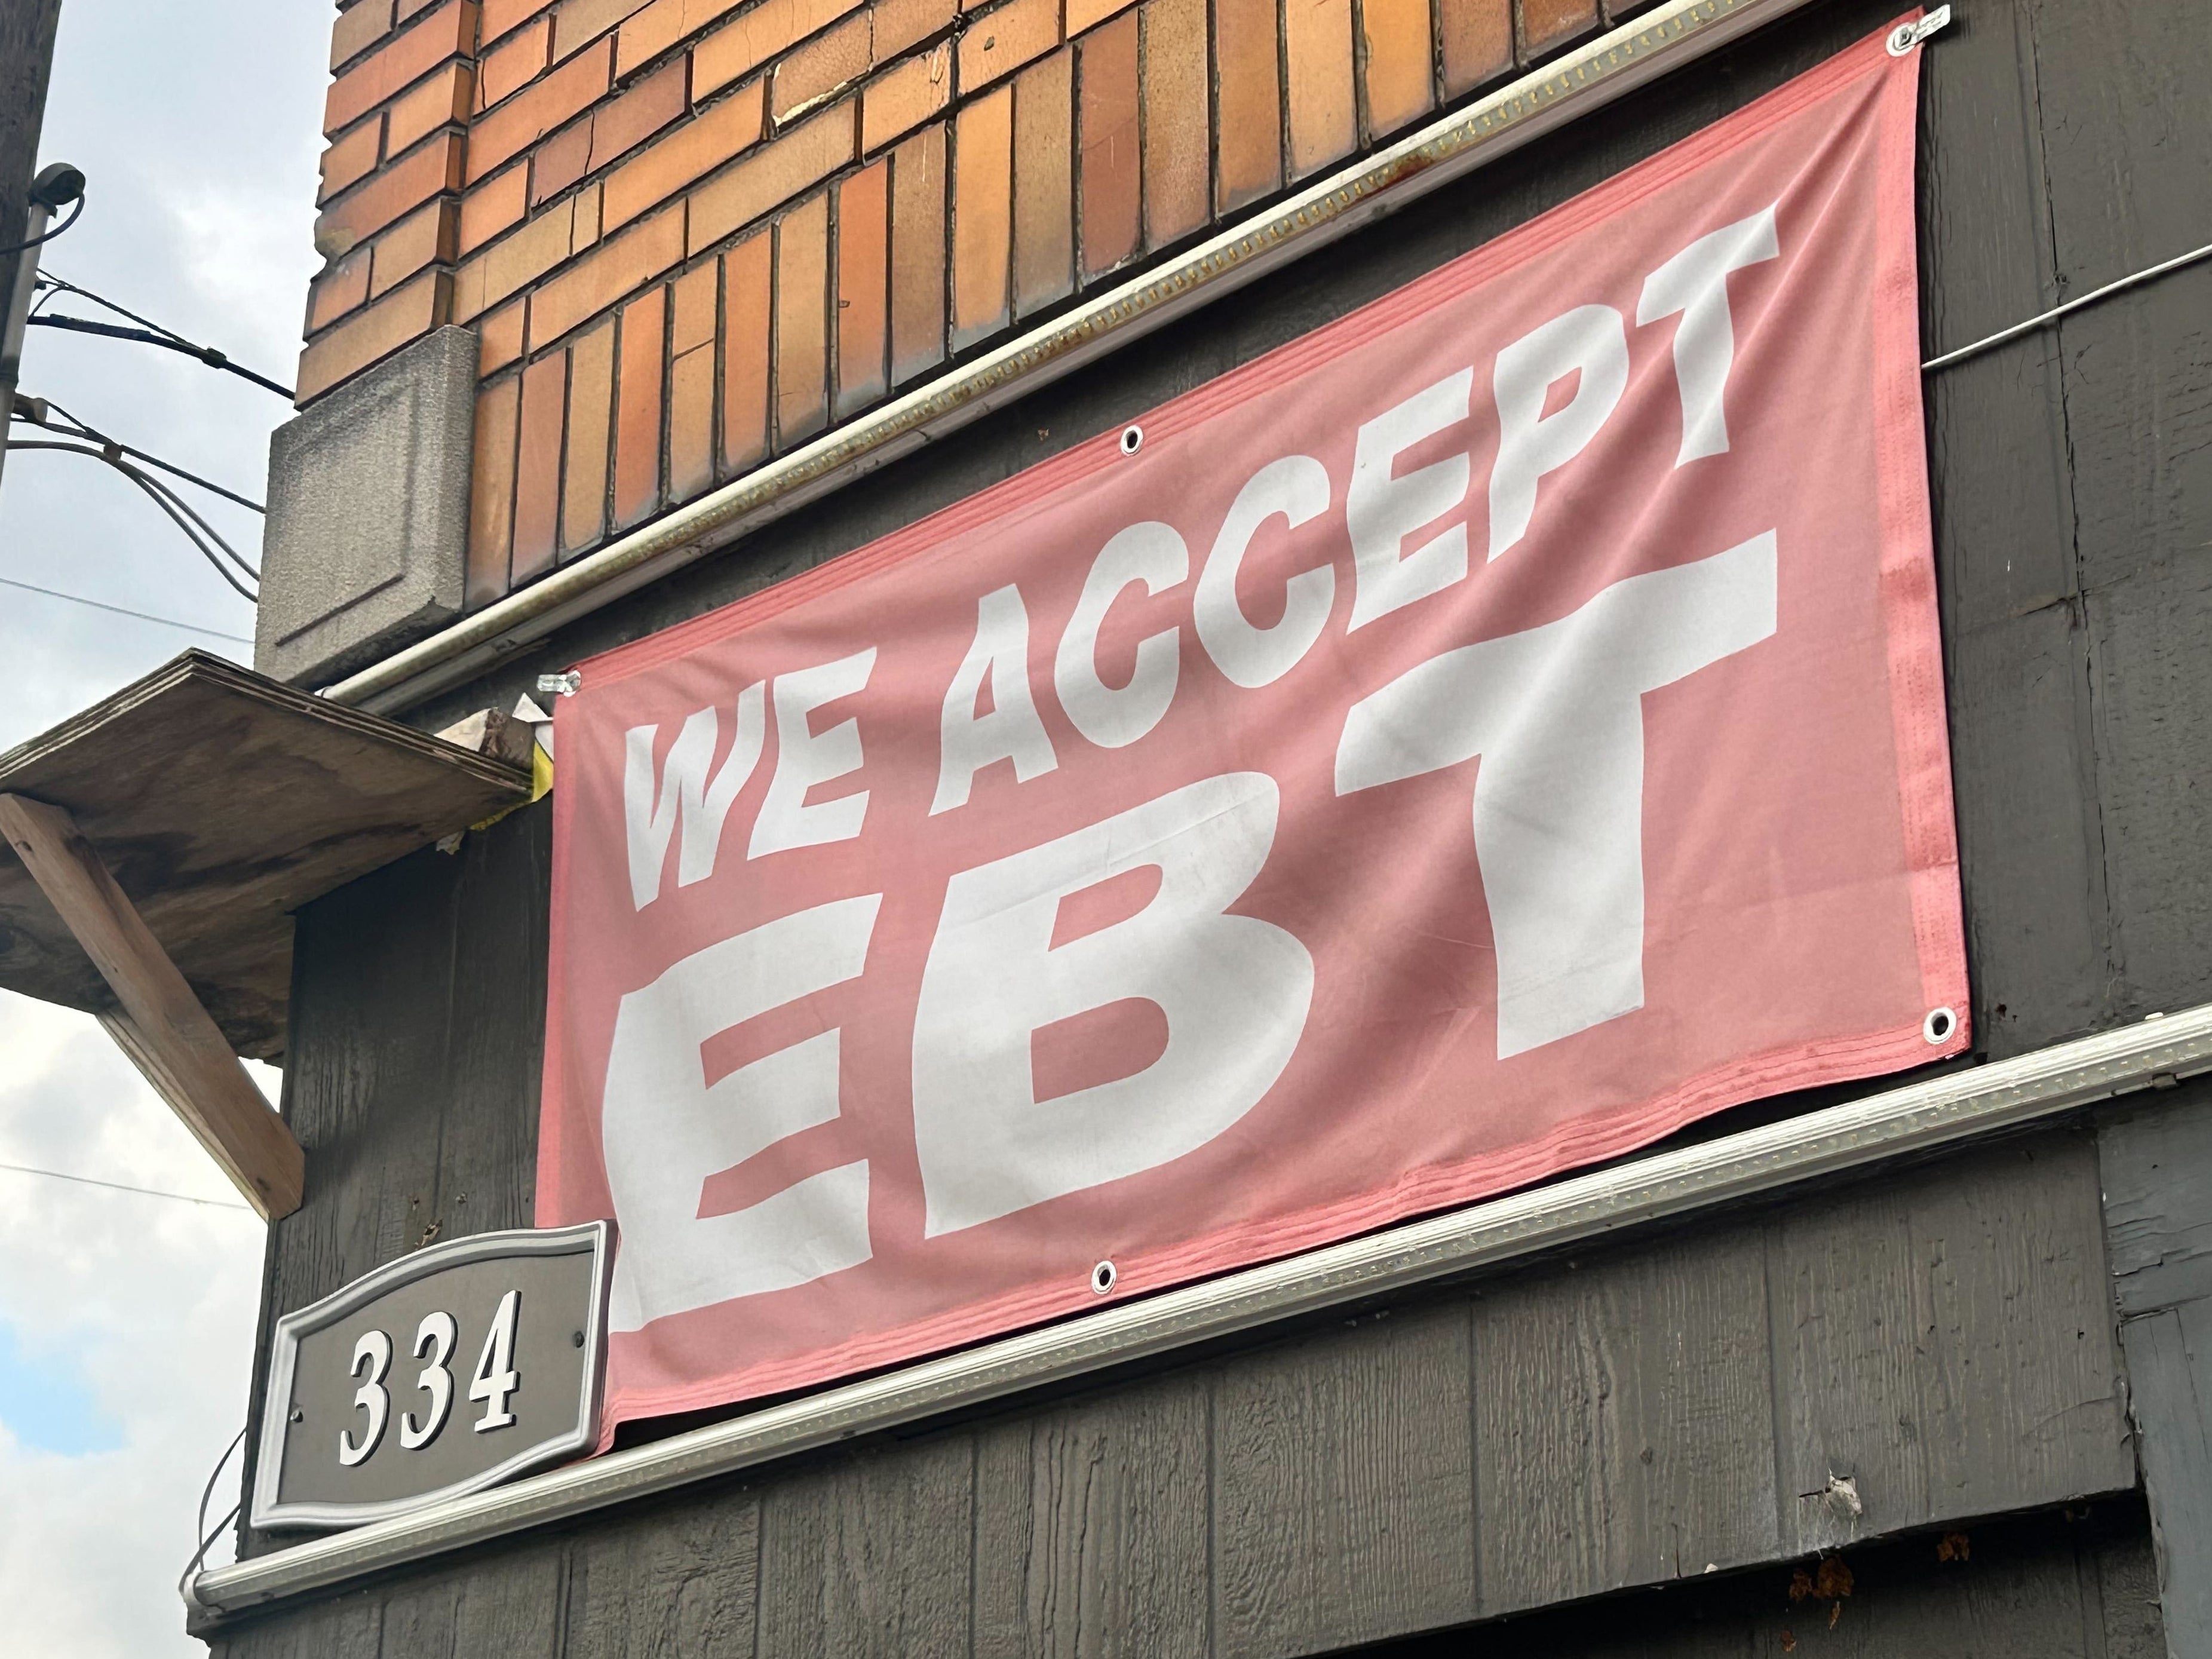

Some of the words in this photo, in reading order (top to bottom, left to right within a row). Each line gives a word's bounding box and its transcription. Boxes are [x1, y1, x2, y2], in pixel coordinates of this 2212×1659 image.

[623, 646, 878, 912] WE
[928, 201, 1781, 817] ACCEPT
[601, 529, 1780, 1335] EBT
[339, 1289, 521, 1466] 334
